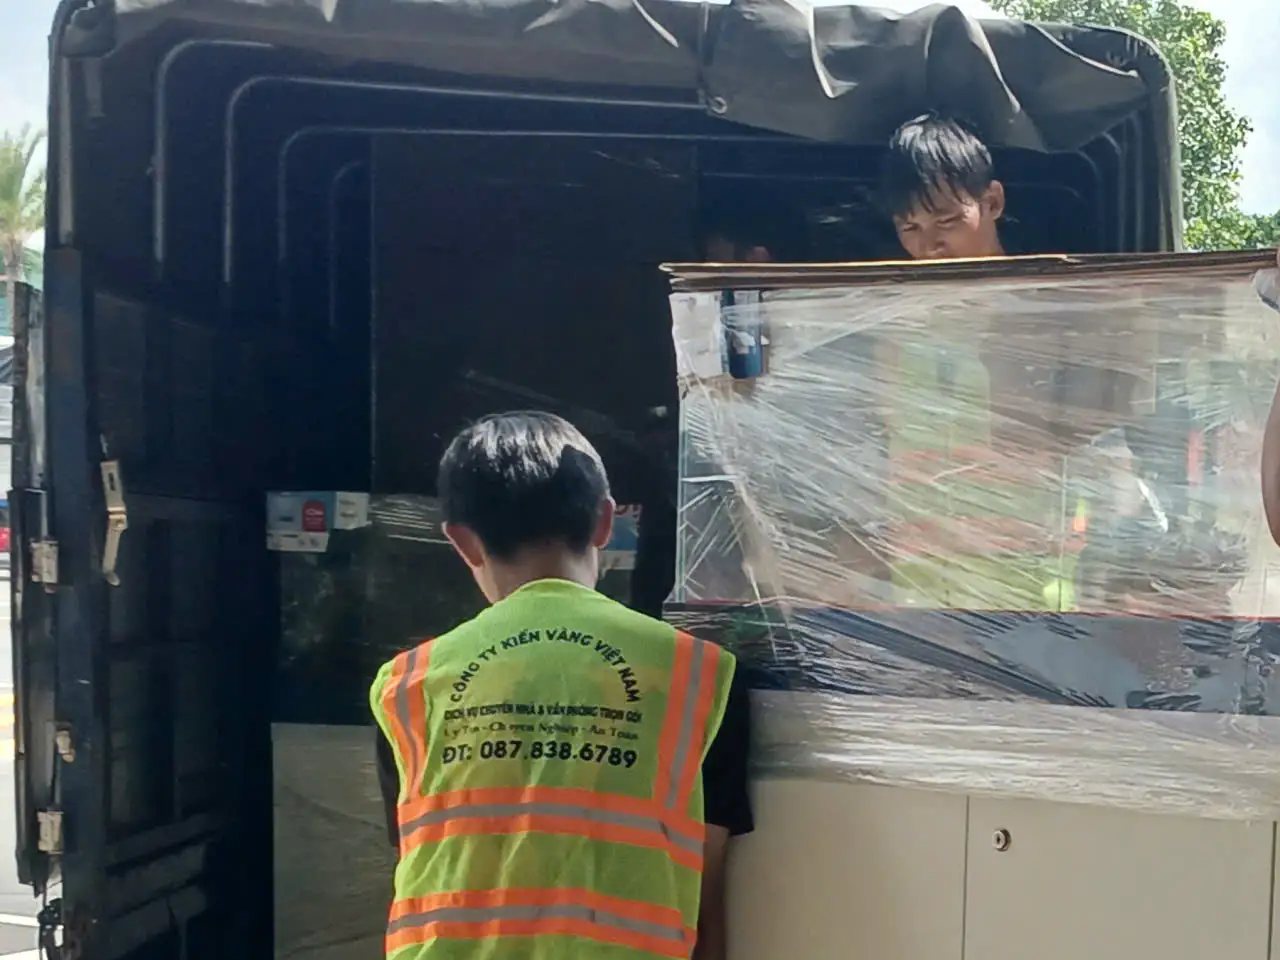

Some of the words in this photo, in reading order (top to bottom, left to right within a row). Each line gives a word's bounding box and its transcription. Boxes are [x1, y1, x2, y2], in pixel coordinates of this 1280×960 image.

[450, 662, 480, 702] CÔNG
[478, 645, 497, 661] TY
[501, 628, 540, 650] KIẾN
[546, 627, 594, 646] VÀNG
[595, 639, 626, 667] VIỆT
[618, 667, 641, 702] NAM
[442, 744, 472, 764] ĐT:
[480, 740, 637, 768] 087.838.6789
